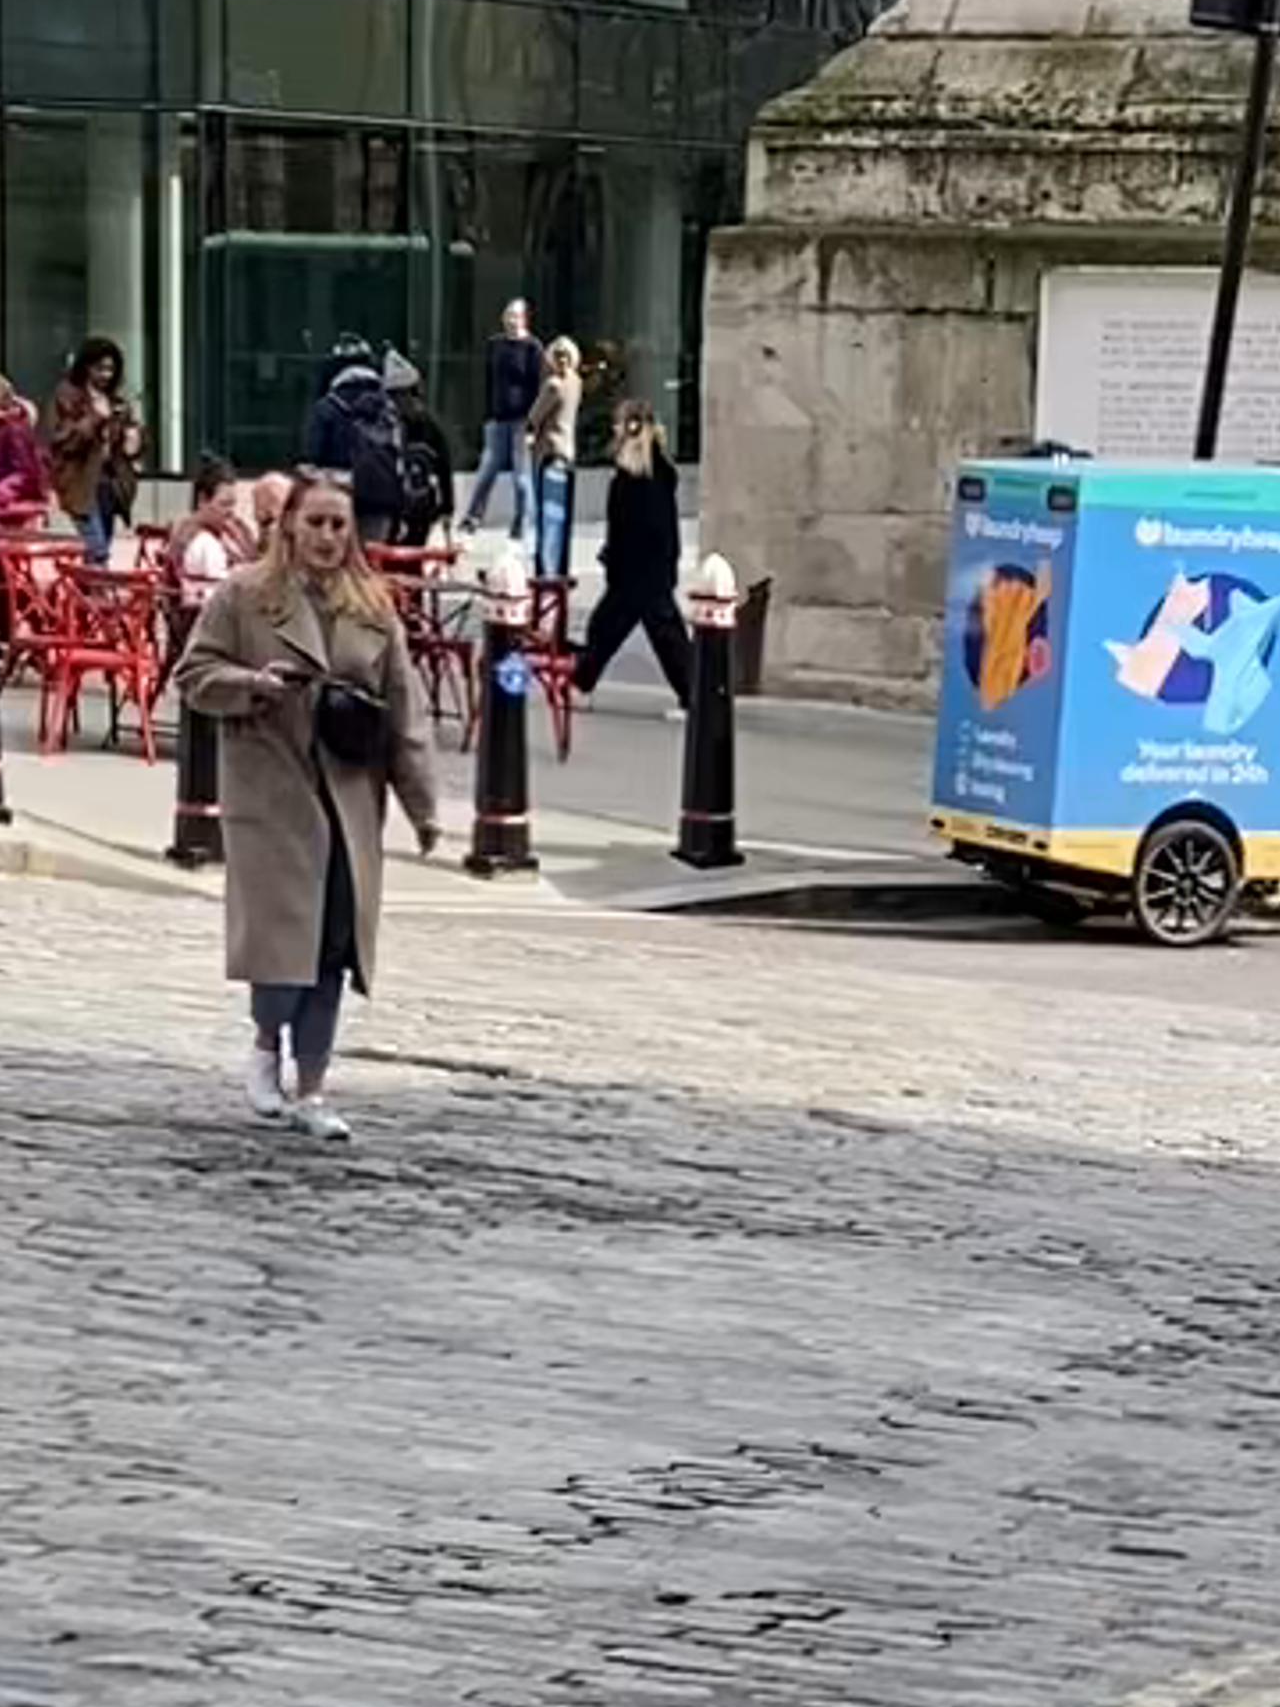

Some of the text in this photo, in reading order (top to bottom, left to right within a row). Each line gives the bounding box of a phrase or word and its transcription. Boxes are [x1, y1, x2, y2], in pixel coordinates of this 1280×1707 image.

[1136, 739, 1258, 763] Your laundry
[1119, 761, 1270, 785] delivered in 24h
